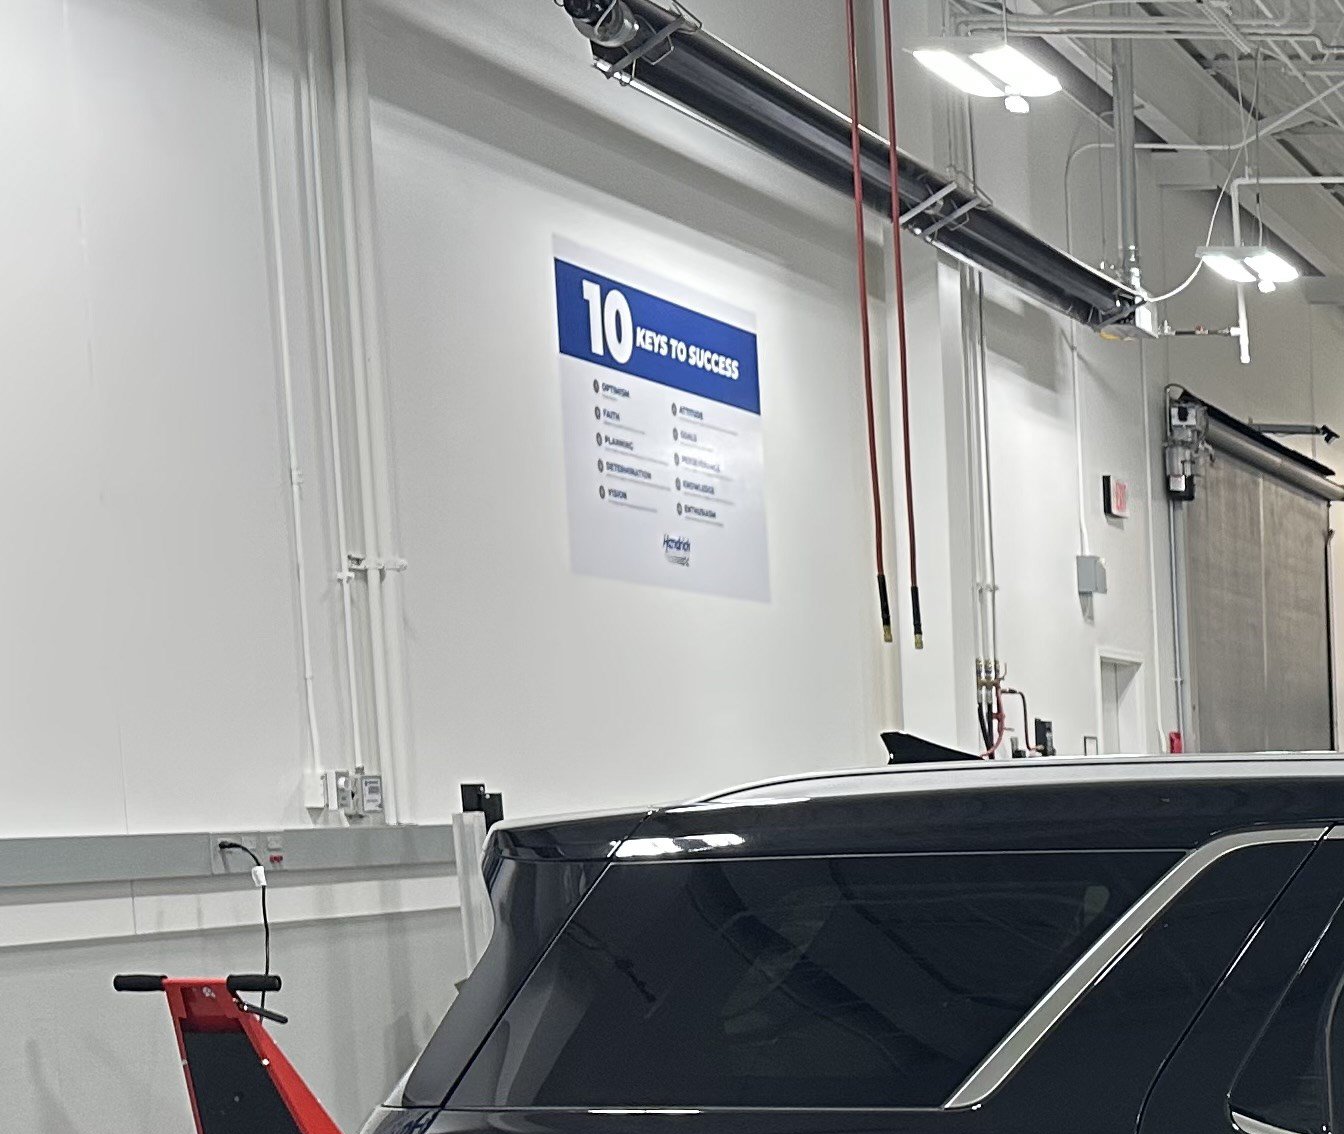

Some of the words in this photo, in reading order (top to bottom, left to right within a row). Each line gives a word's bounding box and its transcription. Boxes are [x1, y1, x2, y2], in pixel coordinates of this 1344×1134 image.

[582, 279, 633, 364] 10
[636, 326, 668, 356] KEYS
[669, 337, 687, 362] TO
[688, 345, 739, 380] SUCCESS
[603, 408, 620, 421] FAITH
[605, 434, 634, 451] PLANNING
